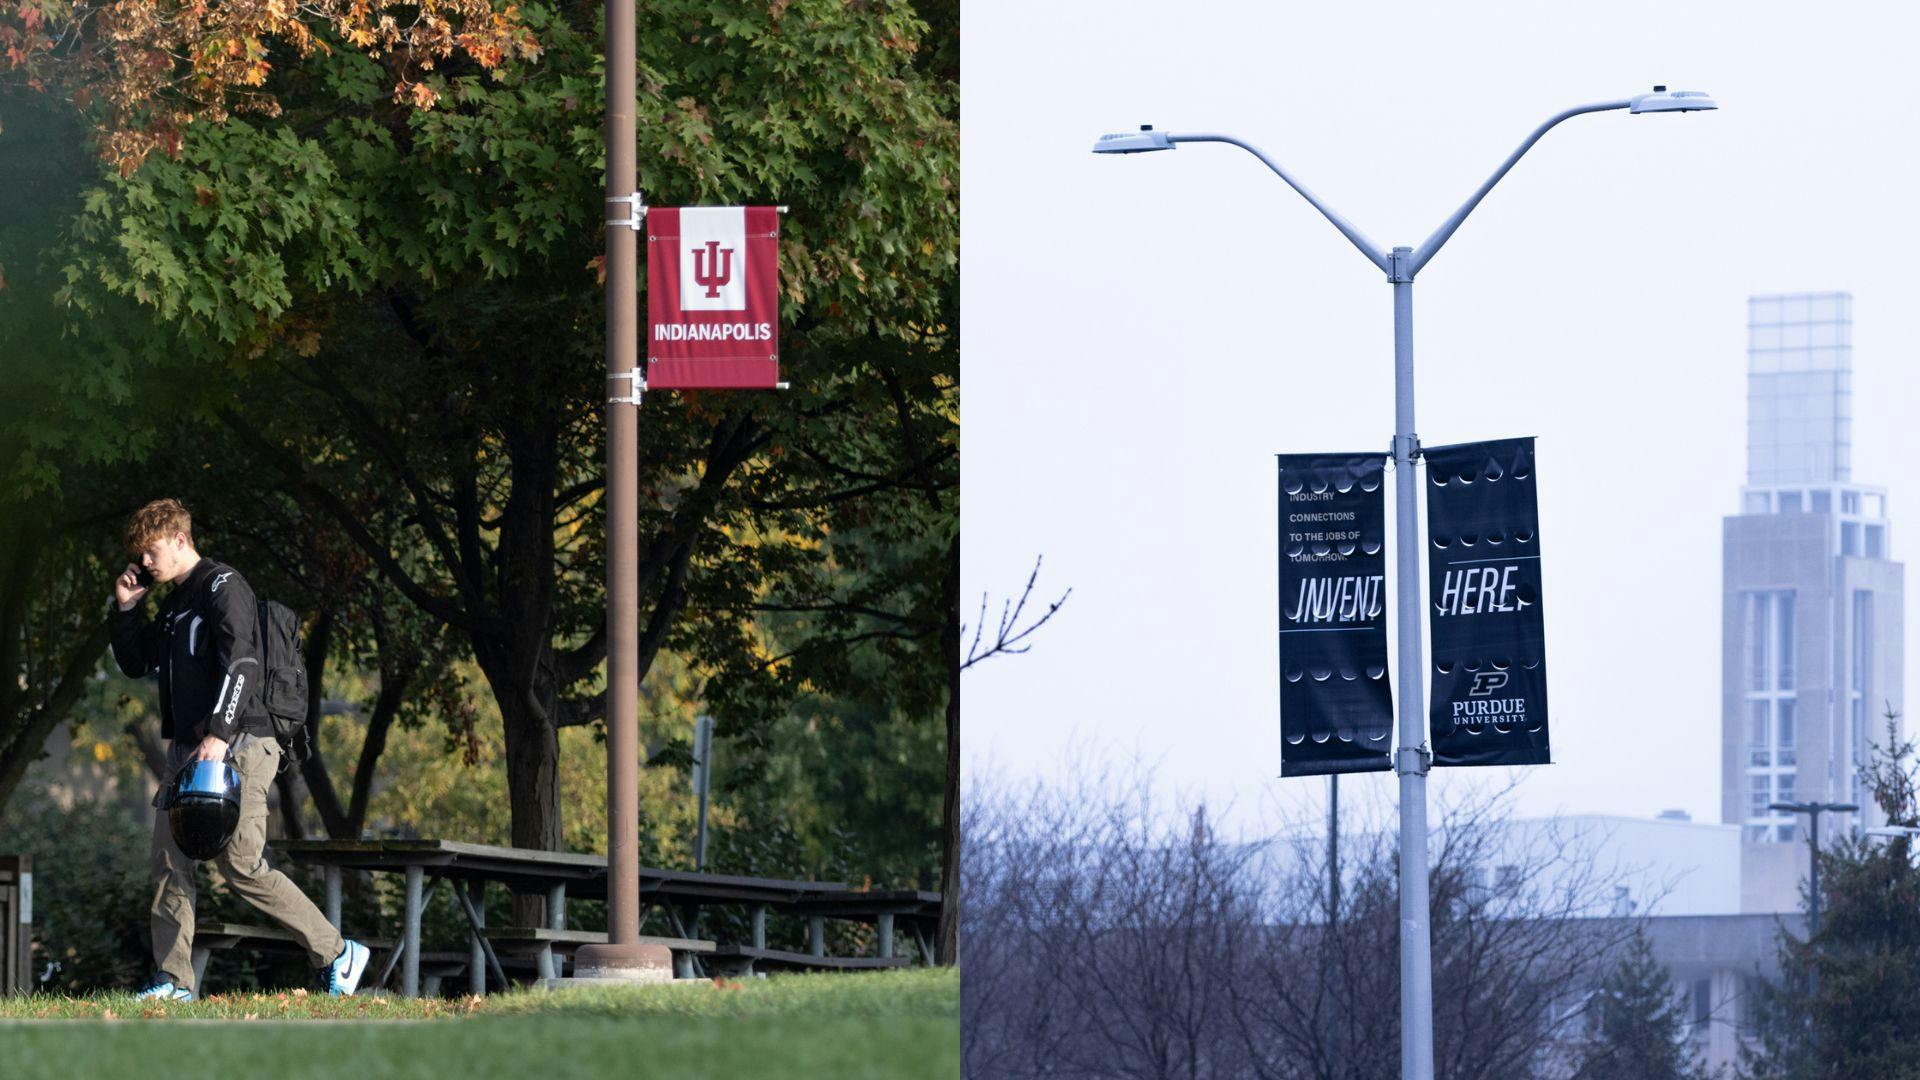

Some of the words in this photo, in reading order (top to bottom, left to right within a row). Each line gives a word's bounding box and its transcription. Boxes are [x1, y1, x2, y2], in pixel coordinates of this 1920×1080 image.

[654, 323, 772, 342] INDIANAPOLIS
[1289, 492, 1335, 502] INDUSTRY
[1289, 512, 1356, 523] CONNECTIONS
[1289, 533, 1303, 542] TO
[1305, 532, 1324, 541] THE
[1325, 531, 1347, 541] JOBS
[1348, 531, 1361, 540] OF
[1296, 575, 1384, 623] INVENT
[1469, 671, 1509, 697] P
[1452, 698, 1526, 717] PURDUE
[1453, 713, 1526, 725] UNIVERSITY
